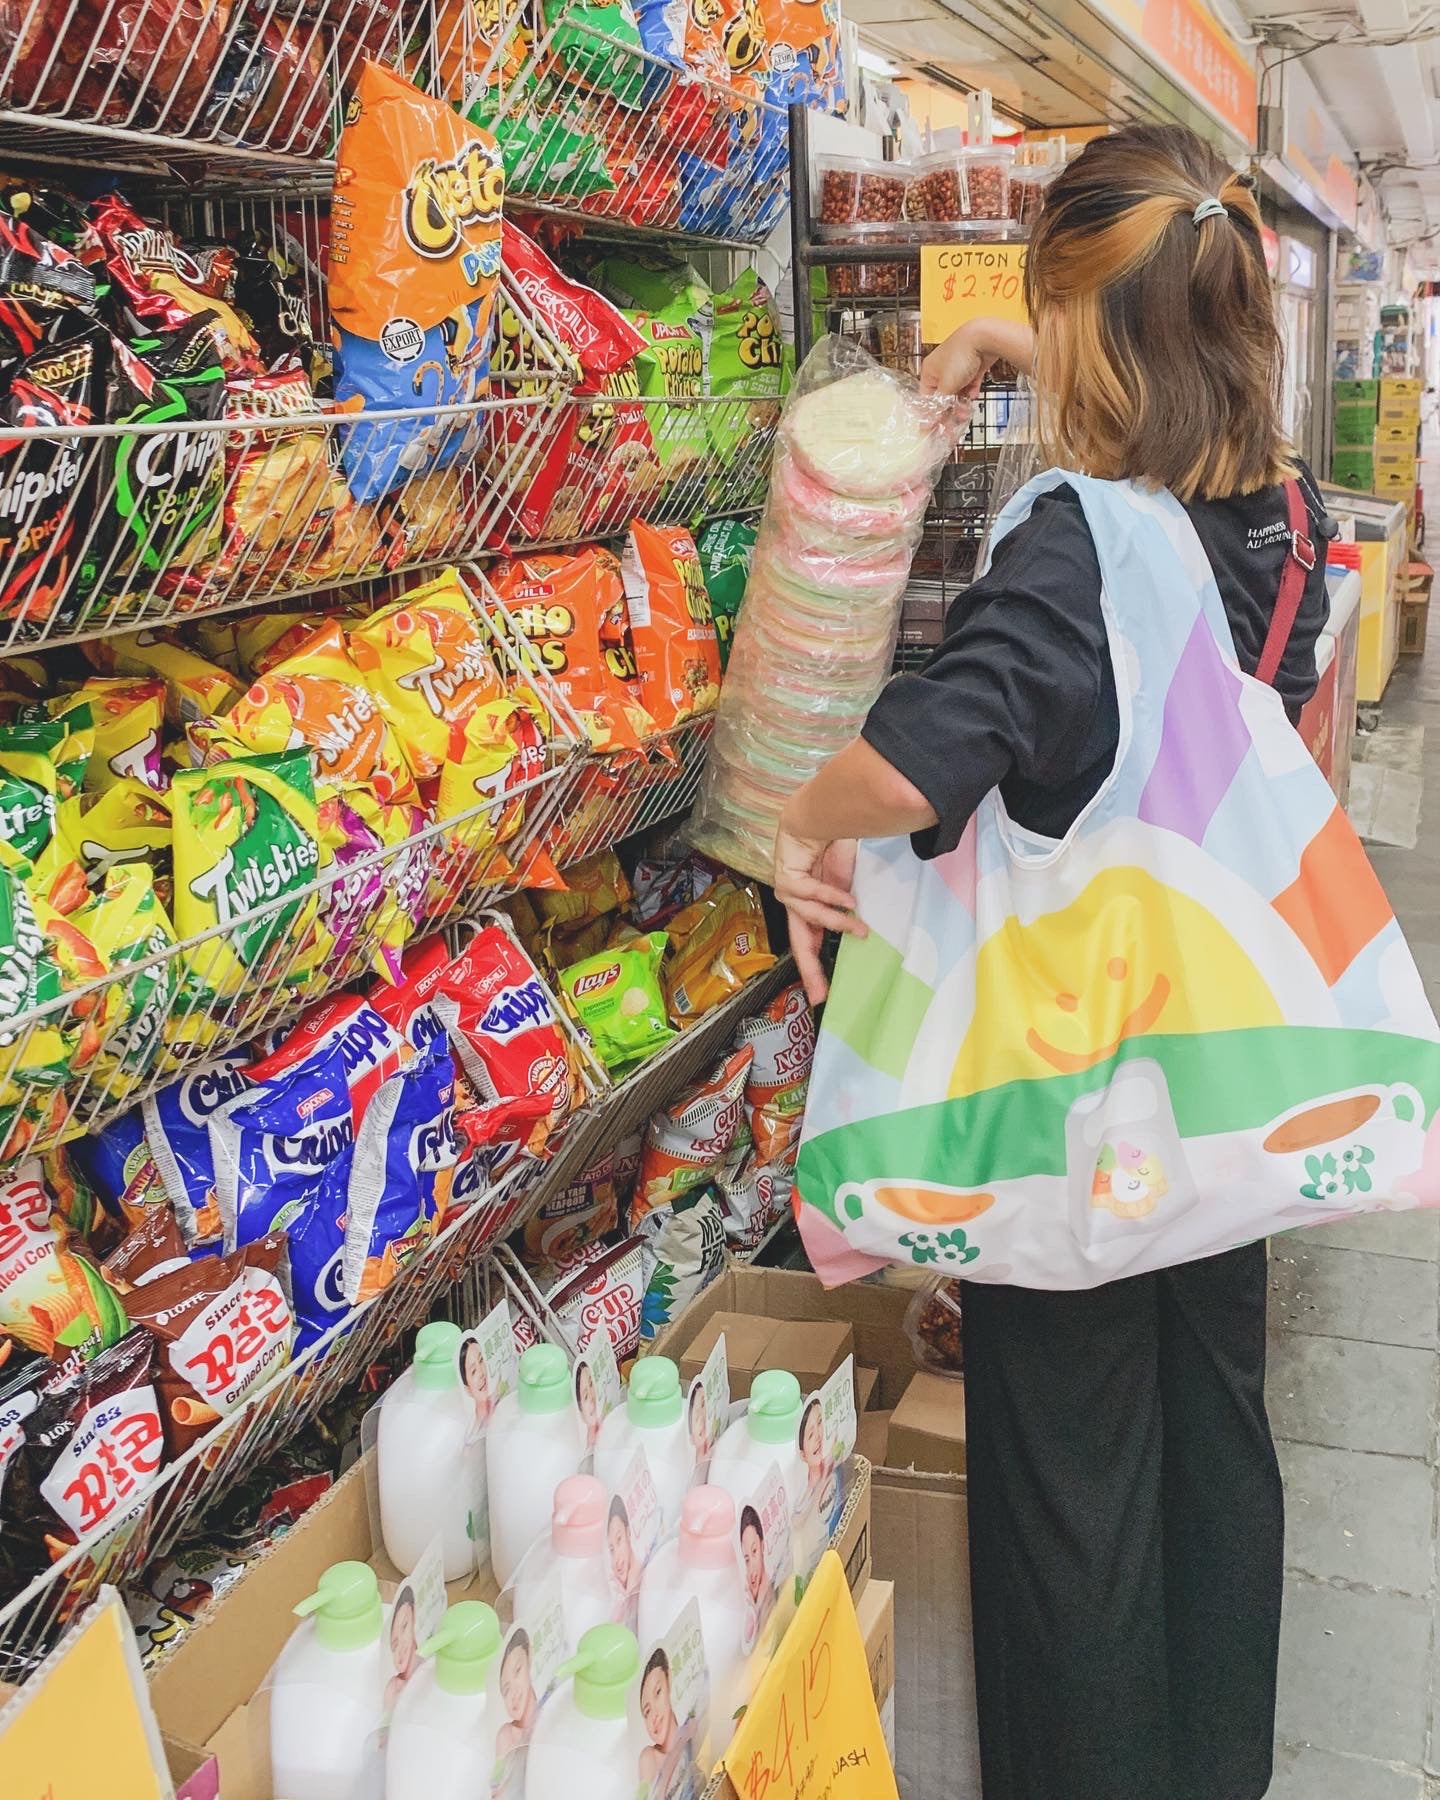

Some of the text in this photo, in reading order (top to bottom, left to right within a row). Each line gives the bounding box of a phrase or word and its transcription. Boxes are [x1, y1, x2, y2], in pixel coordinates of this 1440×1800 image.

[938, 251, 1008, 269] COTTON
[943, 272, 1019, 302] $2.70
[382, 330, 422, 351] EXPORT
[1247, 521, 1286, 538] HAPPINESS
[190, 840, 318, 926] Twisties
[168, 1291, 207, 1319] LOTTE
[205, 1292, 242, 1331] Since
[582, 1285, 632, 1330] CUP
[185, 1289, 290, 1396] 꼬깔콘
[226, 1340, 285, 1404] Grilled Corn
